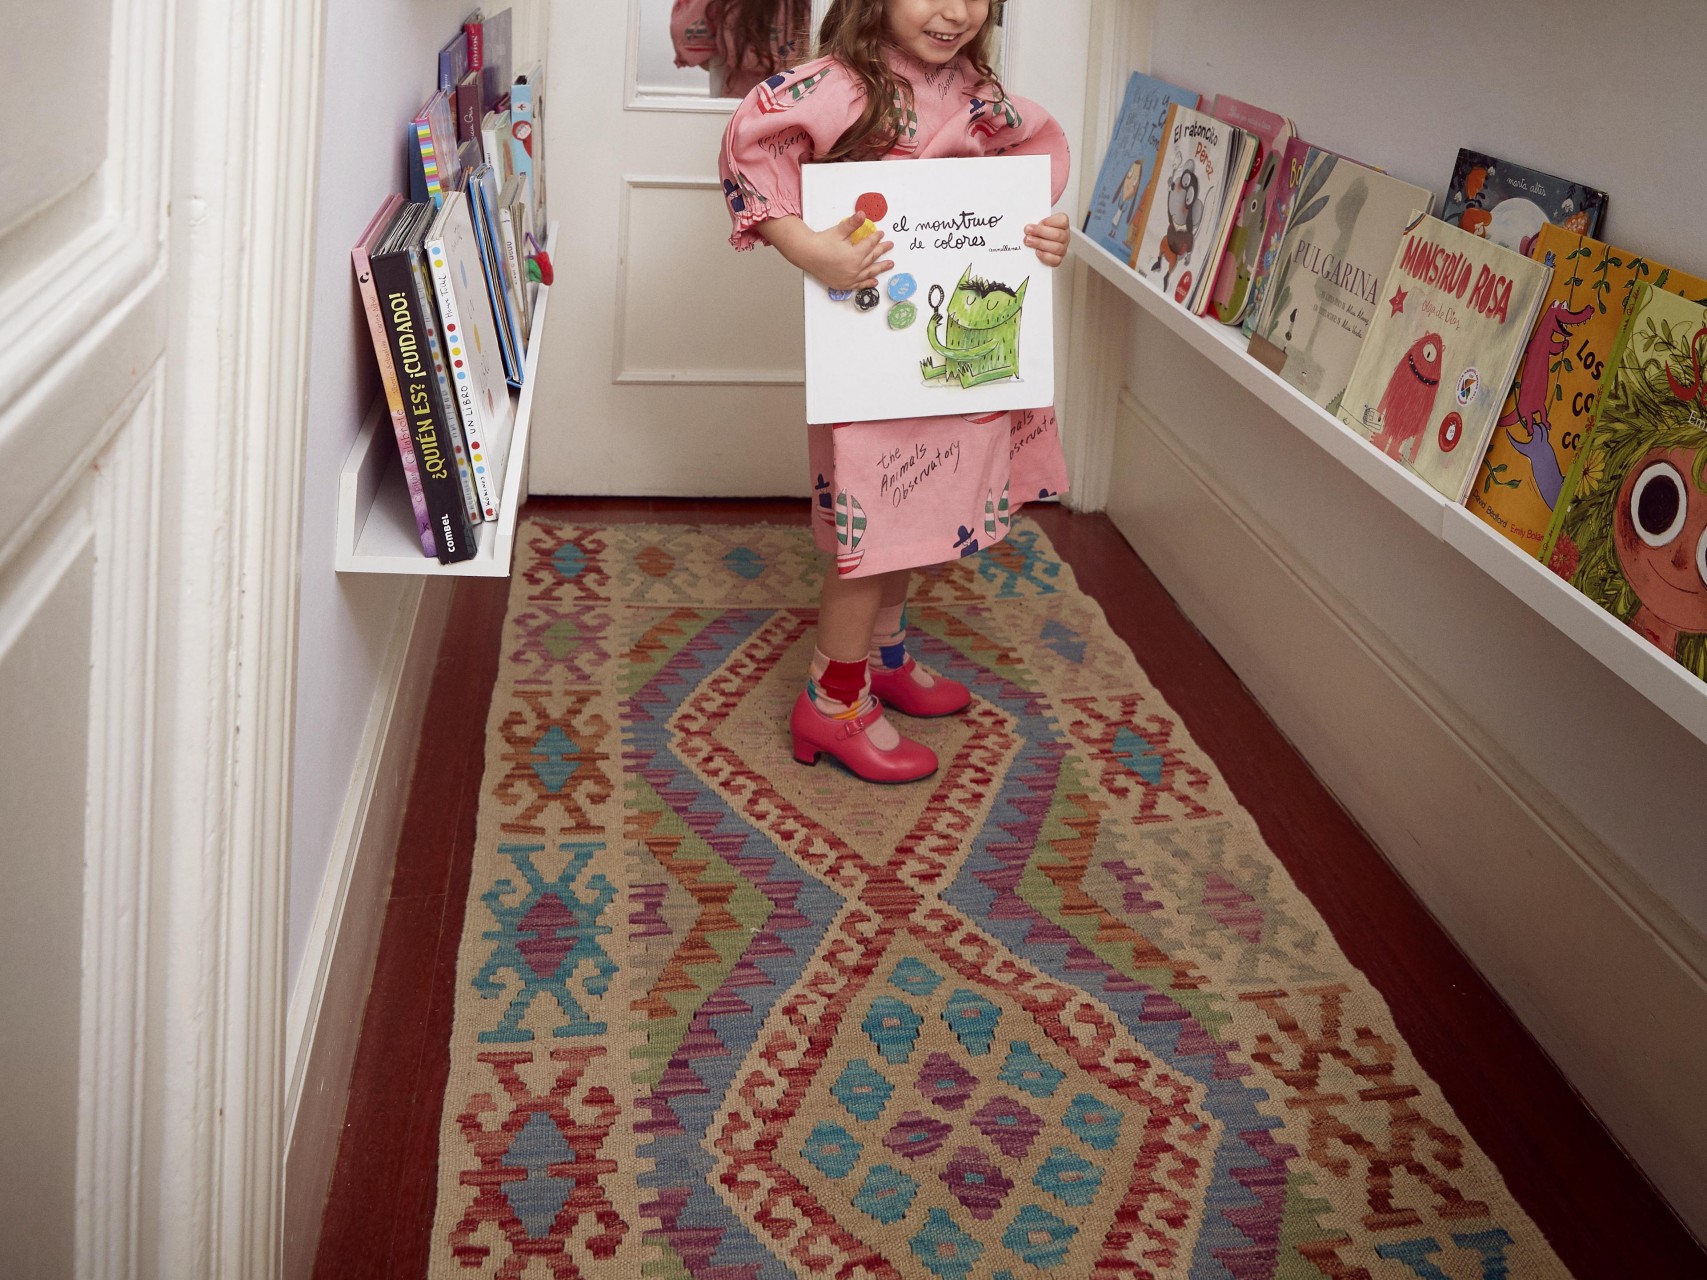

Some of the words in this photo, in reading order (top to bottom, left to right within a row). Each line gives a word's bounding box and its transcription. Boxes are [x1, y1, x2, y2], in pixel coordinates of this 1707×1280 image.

[1174, 125, 1183, 144] El
[1184, 120, 1218, 147] ratoncito
[893, 215, 909, 232] el
[915, 210, 1004, 232] monstruo
[909, 237, 925, 250] de
[934, 232, 986, 250] colores
[1399, 235, 1473, 299] MONSTRUO
[1466, 263, 1513, 325] ROSA
[388, 292, 427, 379] ¡CUIDADO!
[1576, 339, 1605, 381] LOS
[410, 383, 431, 416] ES?
[468, 420, 476, 435] UN
[416, 419, 448, 479] ¿QUIÉN
[876, 447, 902, 470] the
[880, 443, 927, 497] Animals
[892, 440, 961, 508] Observatory
[1473, 488, 1487, 510] David
[1486, 505, 1508, 528] Bedford
[1510, 523, 1526, 539] Emily
